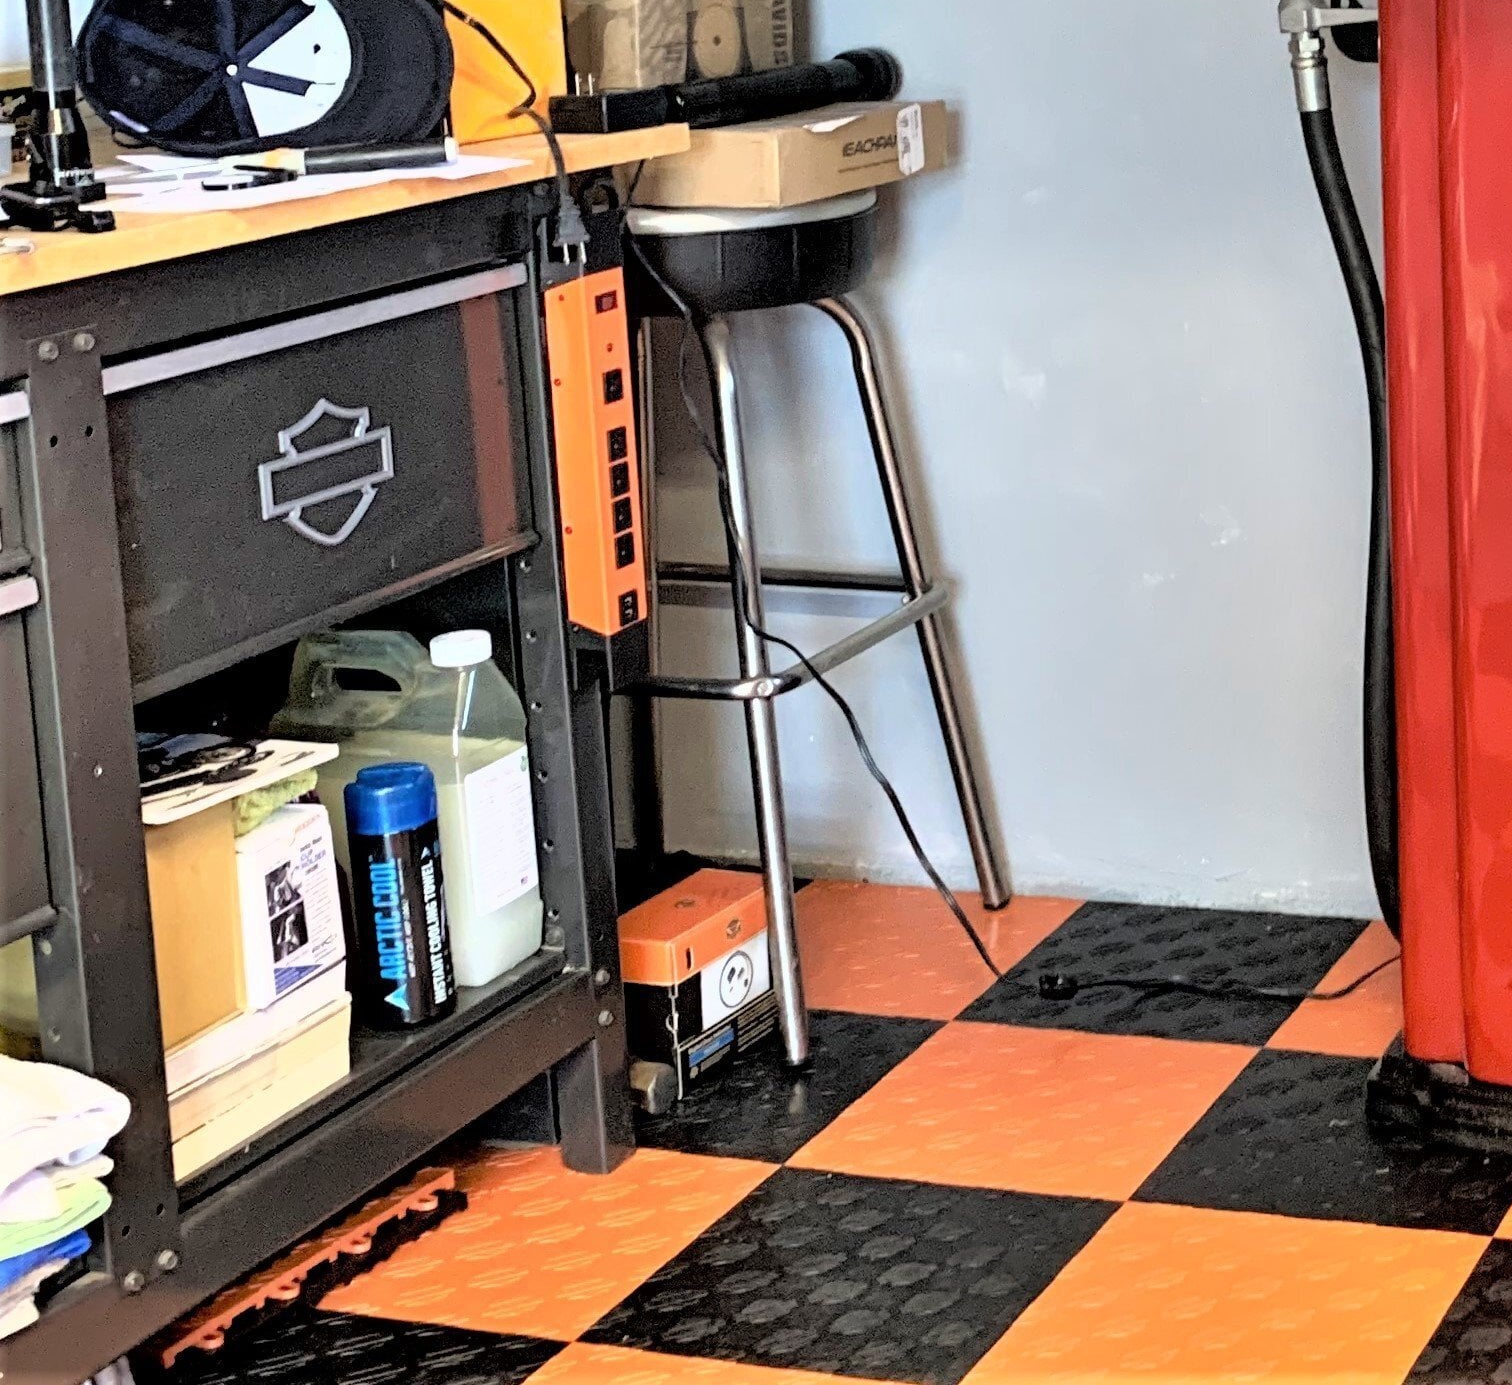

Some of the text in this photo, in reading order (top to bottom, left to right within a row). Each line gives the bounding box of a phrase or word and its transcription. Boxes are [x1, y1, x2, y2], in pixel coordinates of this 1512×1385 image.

[369, 857, 408, 979] ARCTIC COOL
[421, 859, 447, 1004] INSTANT COOLING TOWEL
